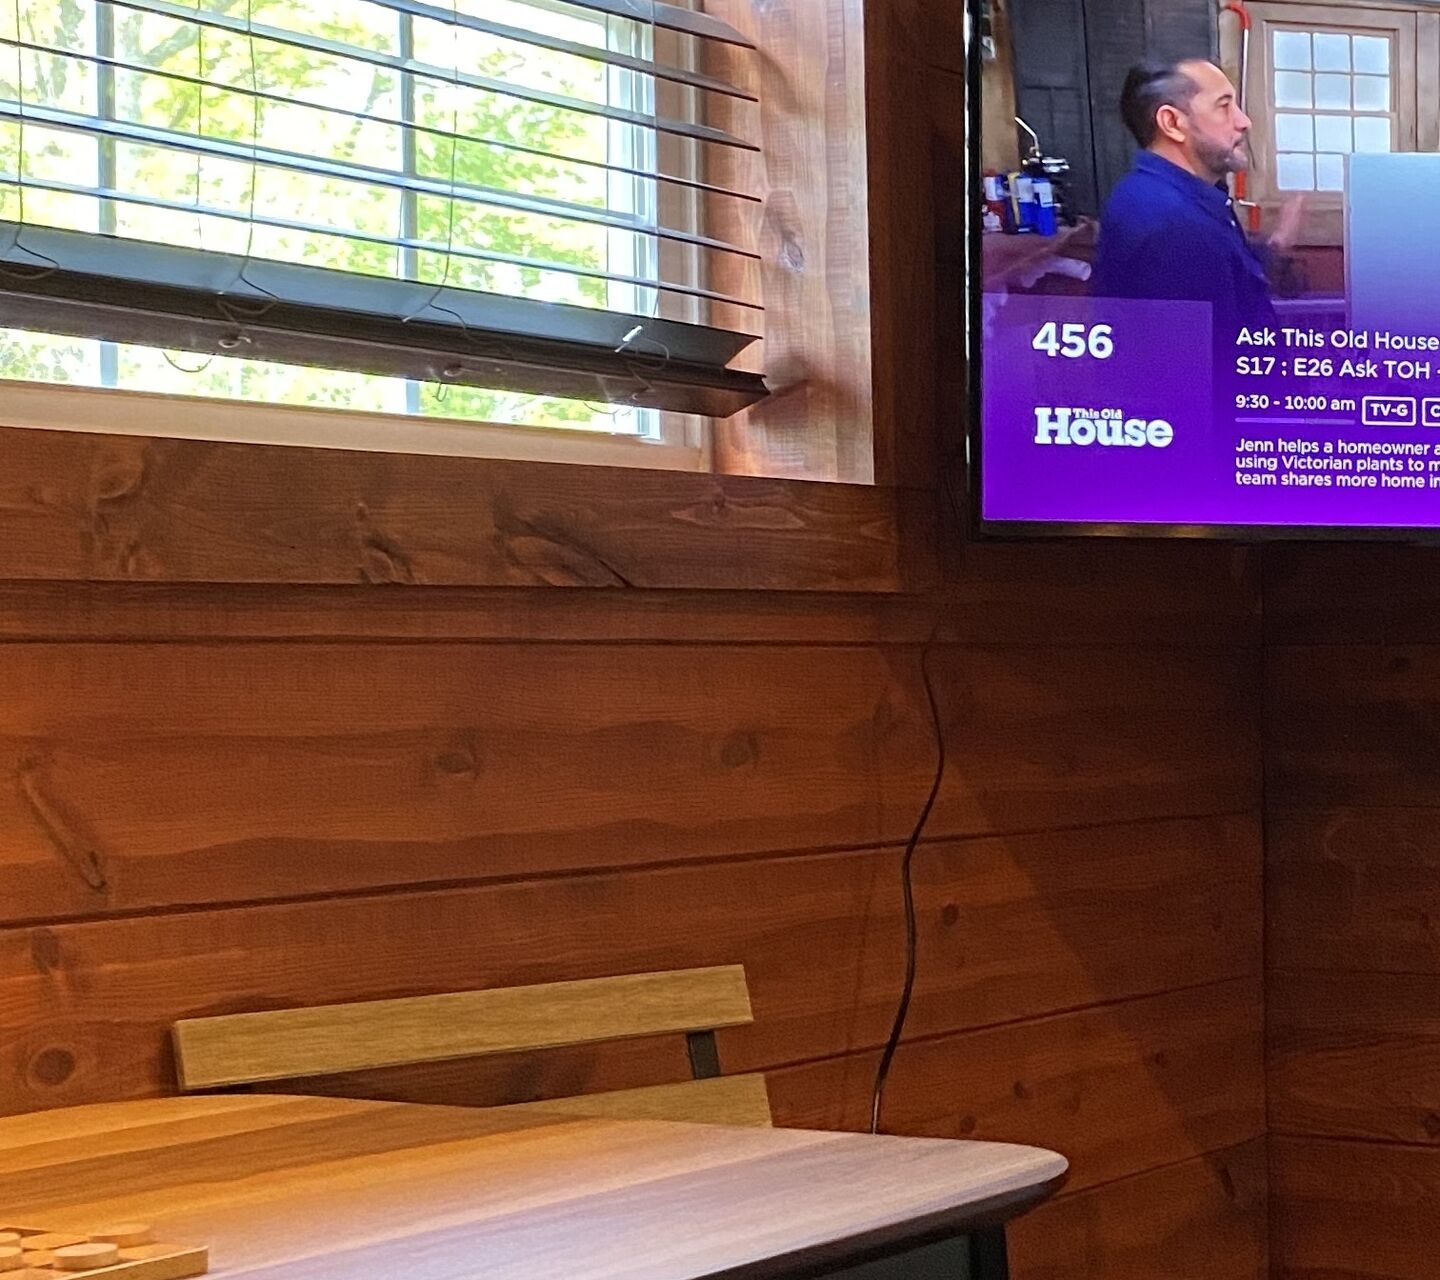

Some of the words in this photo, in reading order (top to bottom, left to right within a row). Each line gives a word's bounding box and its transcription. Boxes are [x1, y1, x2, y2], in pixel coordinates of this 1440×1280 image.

[1032, 322, 1114, 359] 456
[1236, 327, 1276, 347] Ask
[1281, 328, 1325, 348] This
[1330, 330, 1368, 349] Old
[1375, 331, 1440, 351] House
[1236, 356, 1276, 375] S17
[1294, 358, 1333, 377] E26
[1339, 359, 1378, 378] Ask
[1383, 360, 1430, 379] TOH
[1235, 394, 1269, 409] 9:30
[1284, 395, 1327, 410] 10:00
[1330, 399, 1355, 411] am
[1370, 403, 1408, 417] TV-G
[1072, 408, 1100, 419] This
[1101, 408, 1123, 420] Old
[1034, 407, 1174, 448] House
[1235, 438, 1274, 453] Jenn
[1278, 438, 1319, 455] helps
[1323, 441, 1333, 453] a
[1338, 439, 1430, 455] homeowner
[1235, 454, 1278, 471] using
[1282, 455, 1352, 470] Victorian
[1356, 456, 1404, 472] plants
[1407, 457, 1425, 471] to
[1235, 471, 1277, 485] team
[1280, 471, 1332, 486] shares
[1336, 474, 1377, 487] more
[1381, 473, 1425, 488] home
